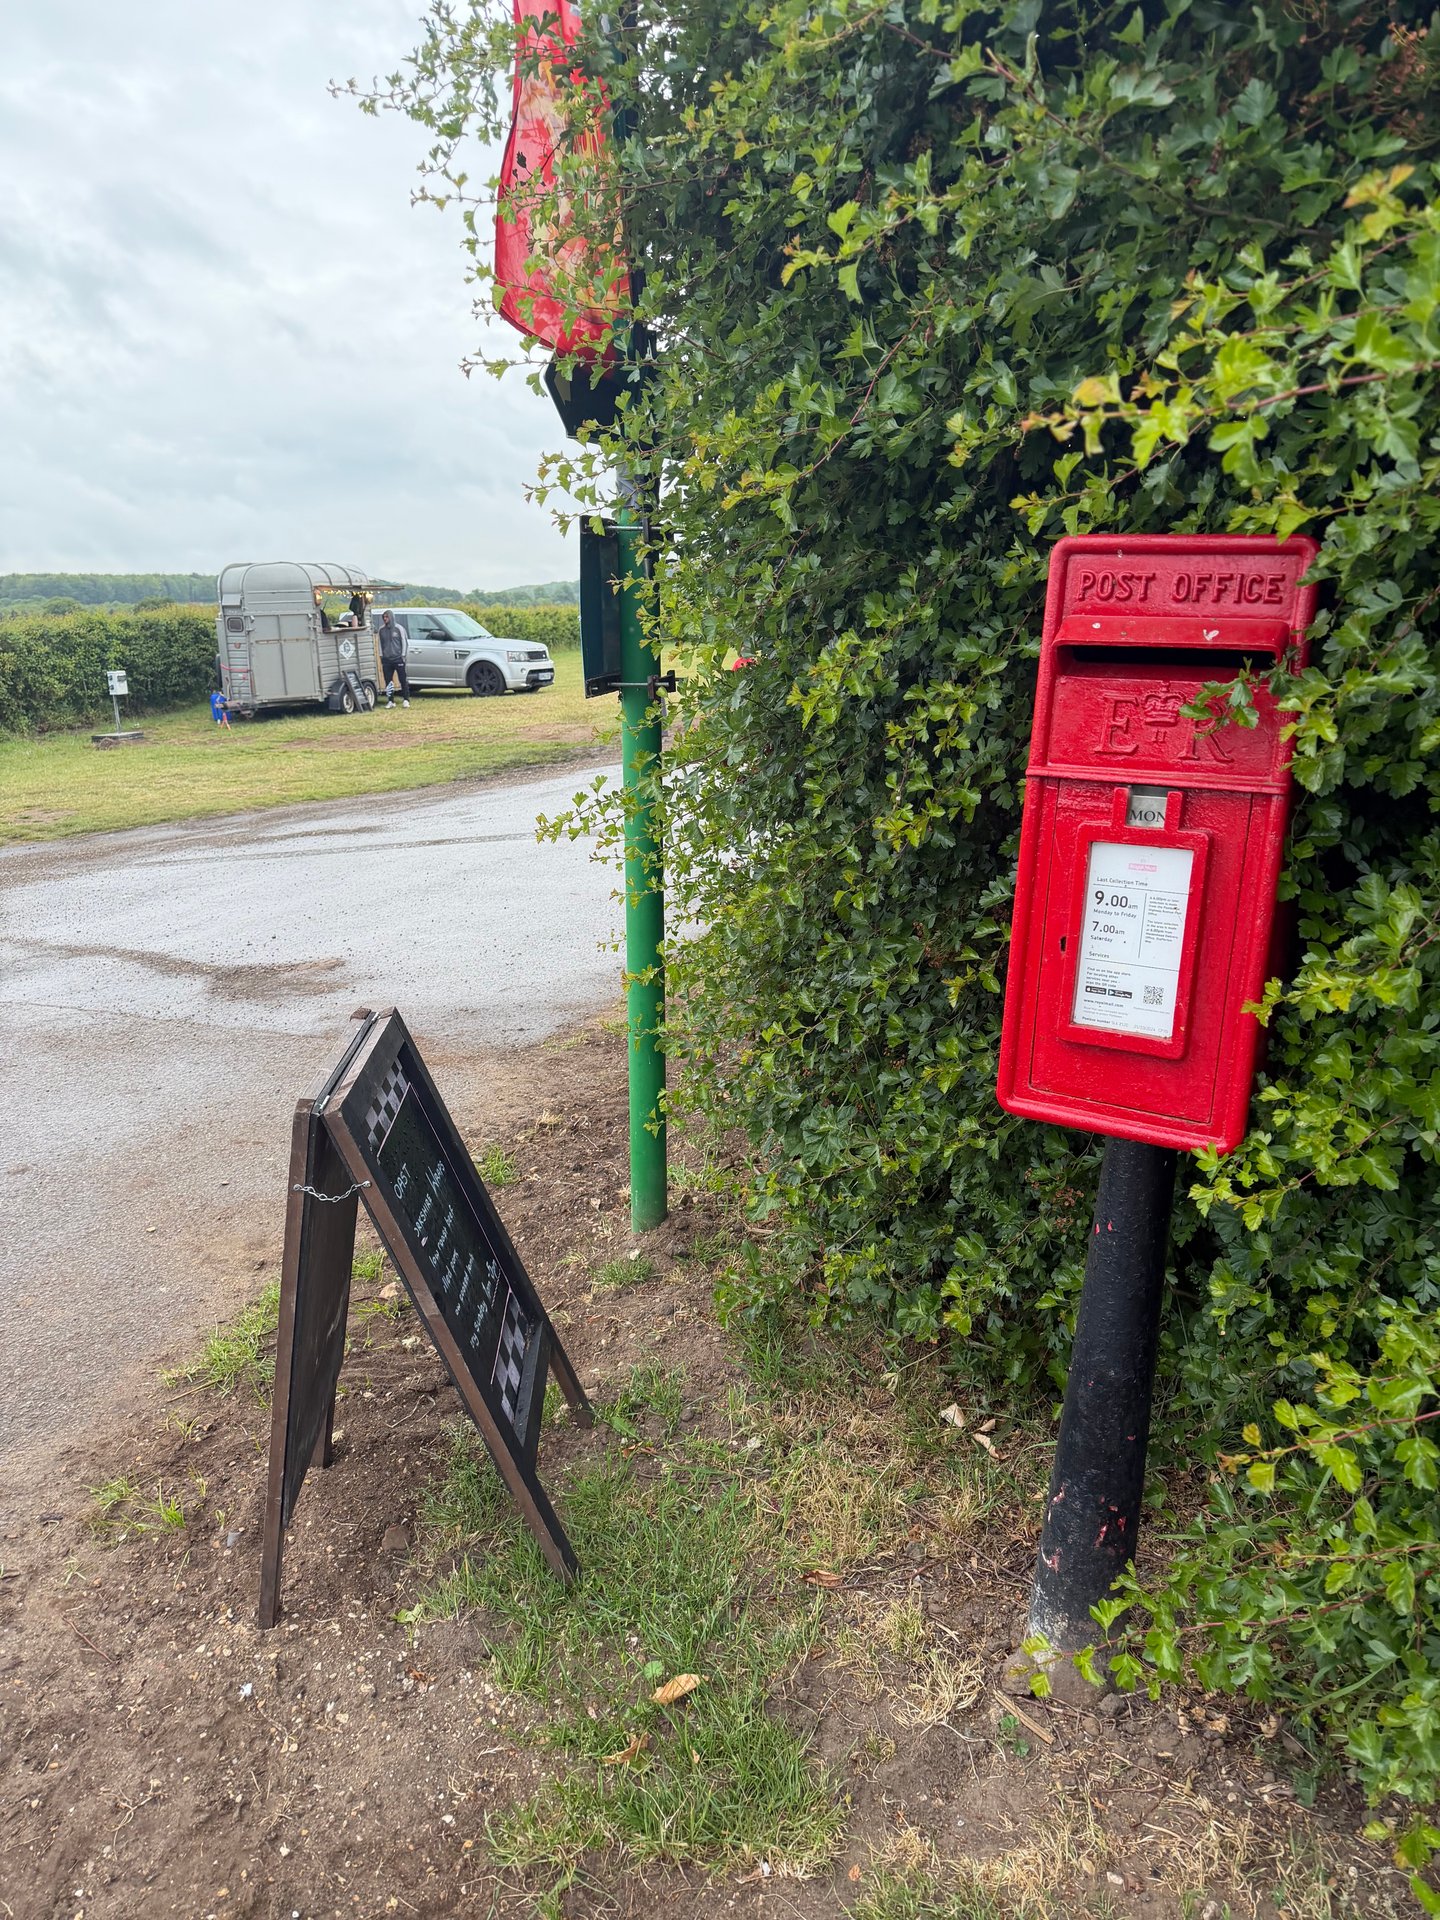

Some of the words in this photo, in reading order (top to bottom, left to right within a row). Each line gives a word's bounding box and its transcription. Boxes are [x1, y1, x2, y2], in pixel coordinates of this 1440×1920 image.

[1077, 571, 1156, 602] POST
[1171, 573, 1286, 604] OFFICE
[1129, 810, 1166, 822] MON
[1095, 890, 1138, 910] 9.00am
[1093, 908, 1112, 917] Monday
[1092, 921, 1125, 935] 7.00am
[394, 1162, 410, 1200] OAST
[414, 1193, 432, 1238] ORKSHIRE
[428, 1250, 439, 1268] low
